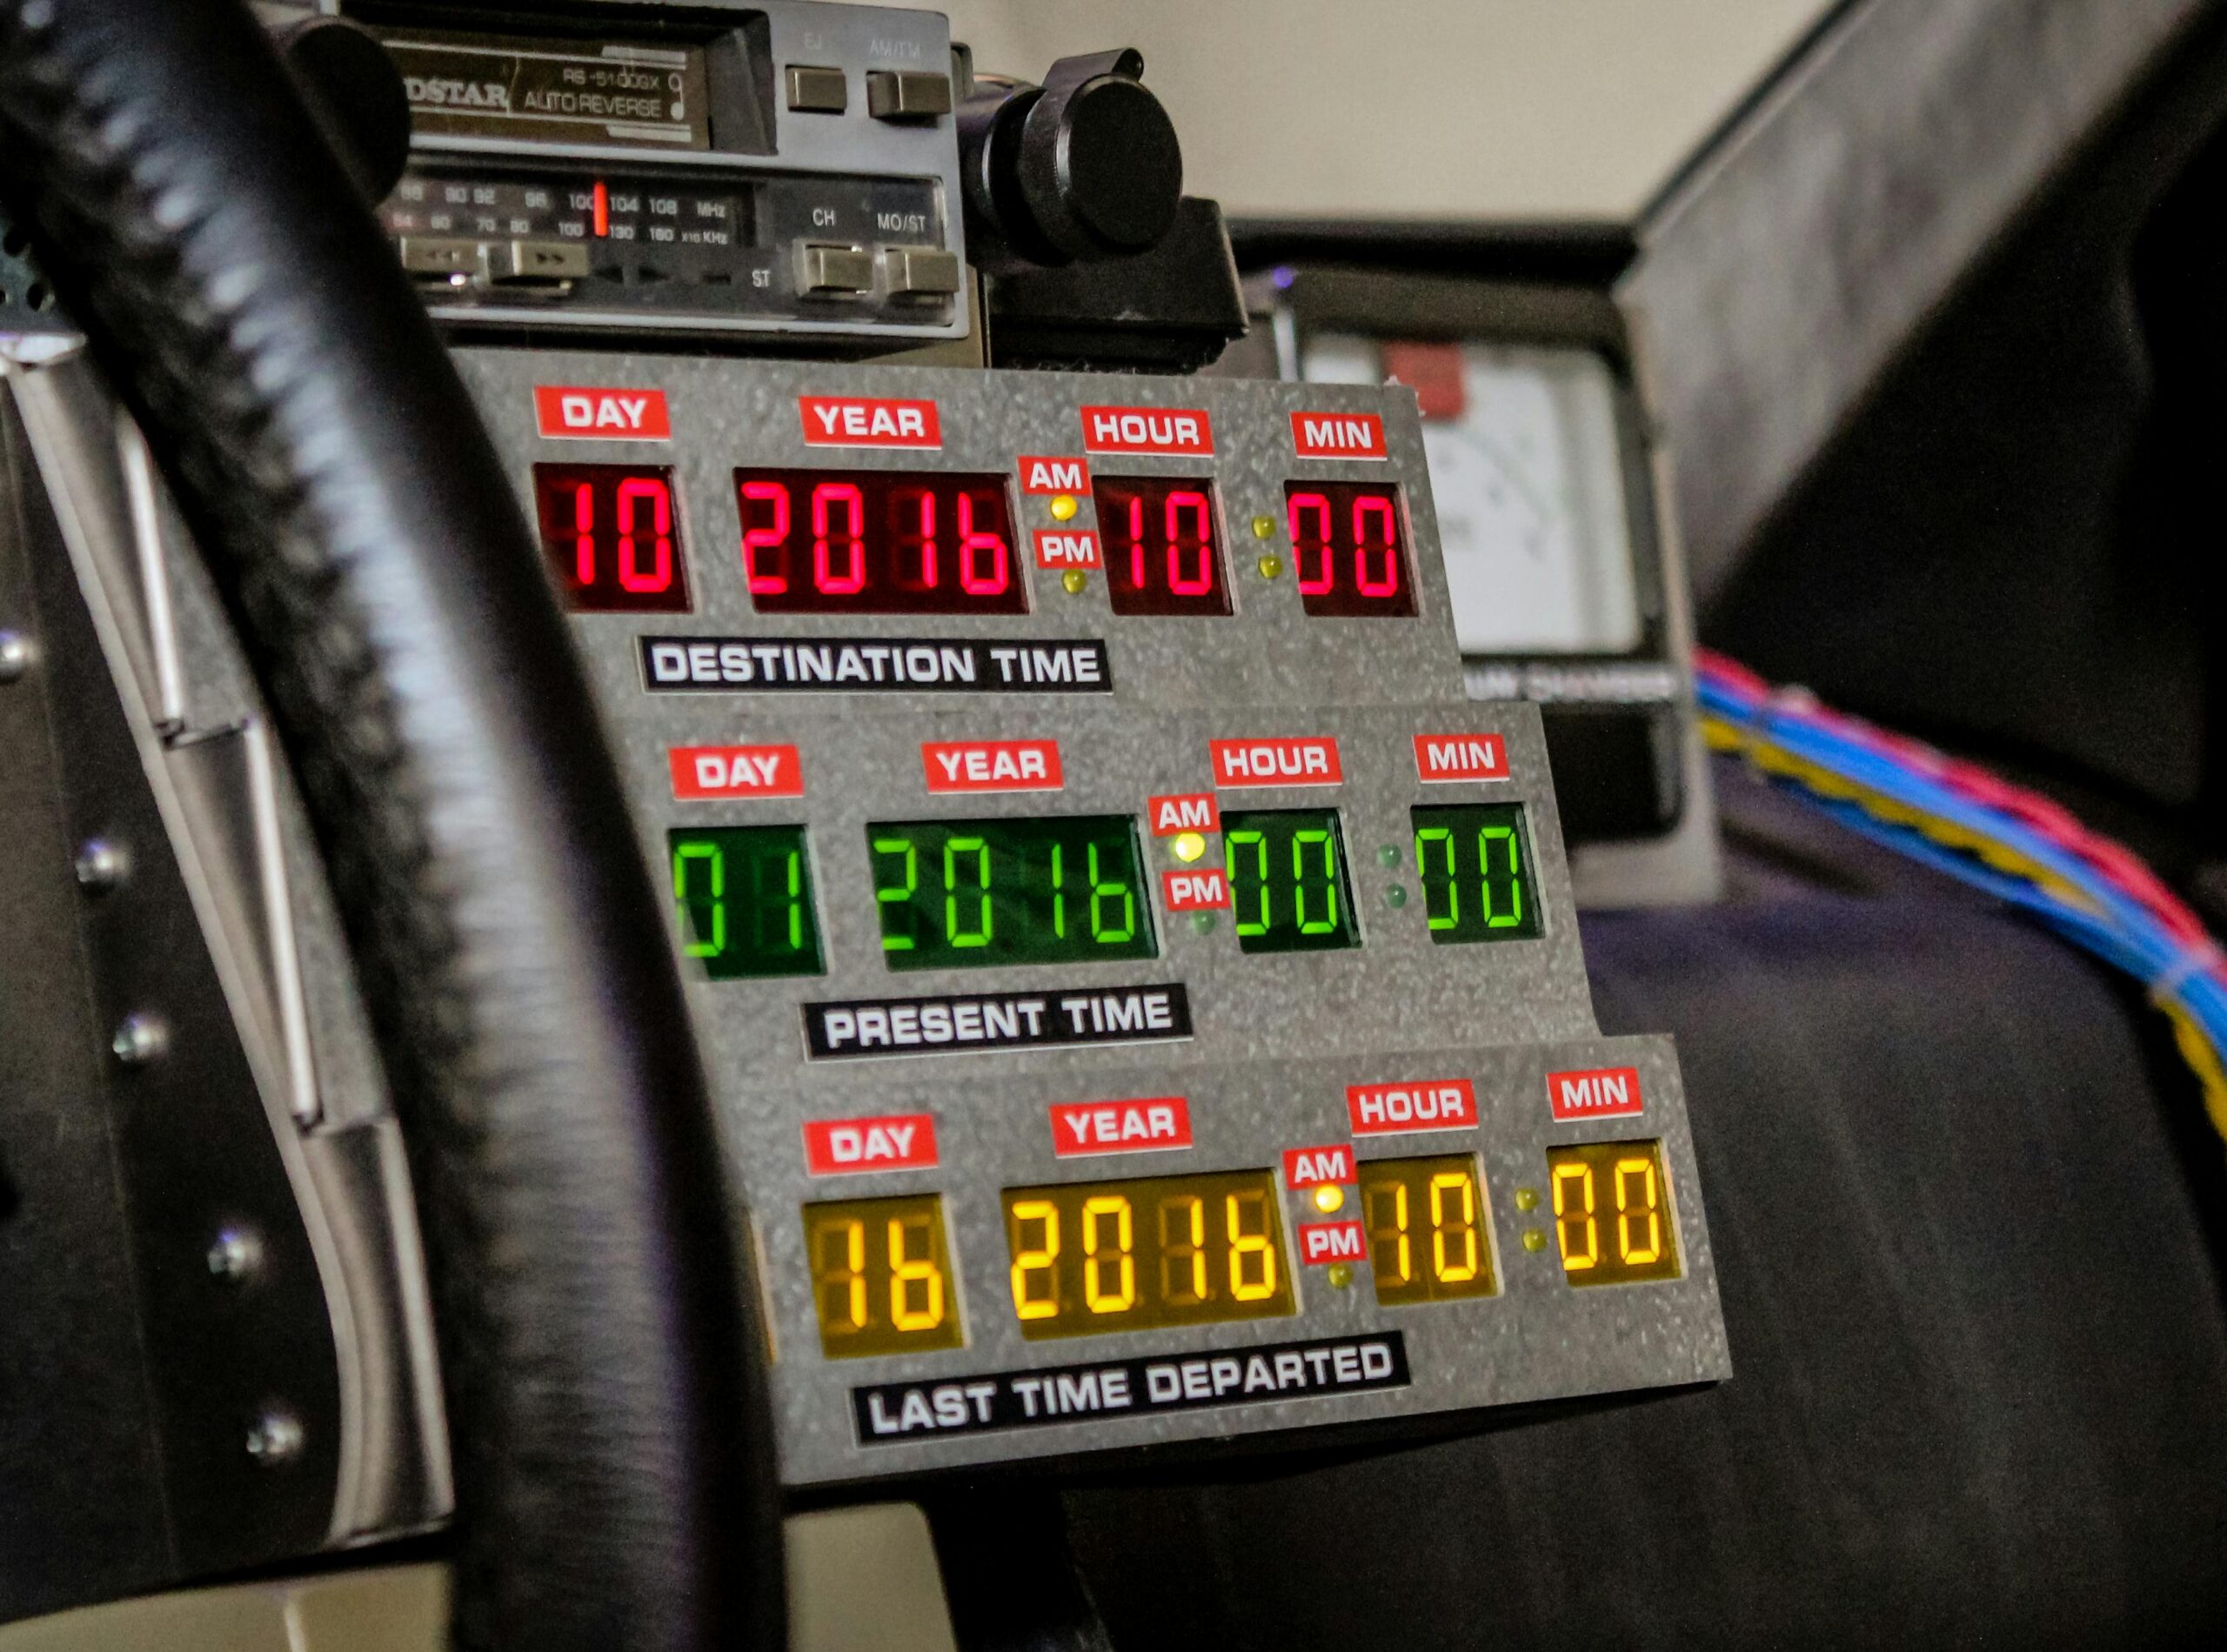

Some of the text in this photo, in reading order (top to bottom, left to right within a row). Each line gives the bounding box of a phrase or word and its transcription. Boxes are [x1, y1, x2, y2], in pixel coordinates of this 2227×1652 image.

[870, 40, 920, 59] AM/FM
[525, 90, 663, 117] AUTO REVERSE
[610, 195, 640, 212] 104
[650, 197, 678, 216] 108
[697, 202, 726, 218] MHz
[813, 208, 835, 226] CH
[877, 213, 926, 232] MO/ST
[752, 269, 771, 289] ST
[561, 396, 647, 429] DAY
[814, 405, 925, 437] YEAR
[1093, 413, 1200, 445] HOUR
[1304, 419, 1373, 449] MIN
[1028, 463, 1082, 490] AM
[576, 478, 672, 592] 10
[740, 481, 1010, 595] 2016
[1040, 537, 1094, 563] PM
[1129, 491, 1212, 596] 10
[1287, 492, 1398, 597] 00
[651, 644, 1100, 684] DESTINATION TIME
[695, 756, 779, 788] DAY
[936, 750, 1047, 781] YEAR
[1222, 746, 1328, 777] HOUR
[1427, 740, 1495, 771] MIN
[1157, 799, 1211, 829] AM
[873, 837, 1134, 950] 2016
[1170, 874, 1221, 905] PM
[1225, 830, 1338, 936] 00
[1414, 826, 1521, 929] 00
[673, 840, 802, 958] 01
[823, 994, 1174, 1048] PRESENT TIME
[1358, 1087, 1465, 1124] HOUR
[1560, 1075, 1629, 1109] MIN
[1064, 1106, 1176, 1144] YEAR
[828, 1125, 915, 1163] DAY
[1294, 1150, 1348, 1182] AM
[1395, 1172, 1477, 1282] 10
[1552, 1158, 1661, 1271] 00
[1010, 1194, 1277, 1320] 2016
[1307, 1227, 1360, 1258] PM
[848, 1218, 944, 1332] 16
[869, 1343, 1392, 1435] LAST TIME DEPARTED
